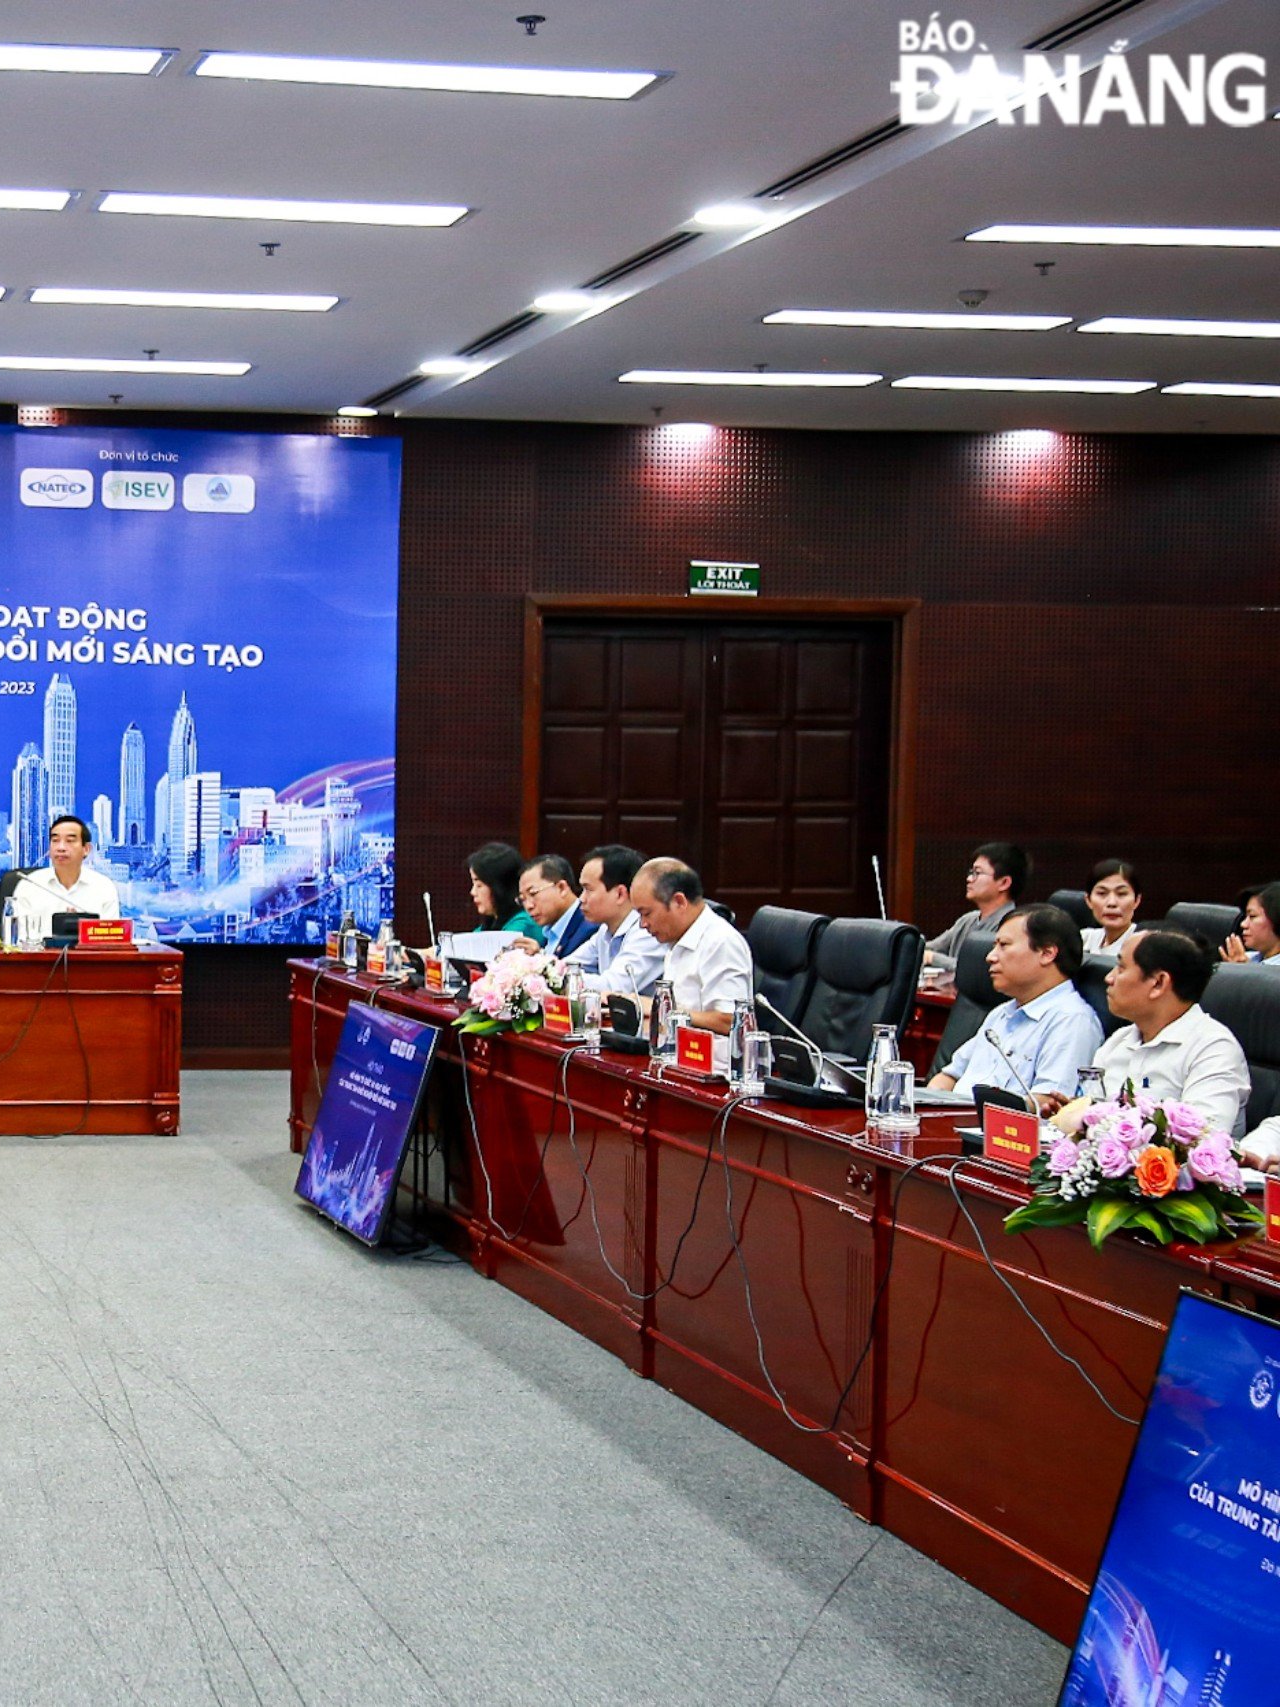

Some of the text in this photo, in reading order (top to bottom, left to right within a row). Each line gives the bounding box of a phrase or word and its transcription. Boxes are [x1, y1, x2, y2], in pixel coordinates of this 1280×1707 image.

[99, 450, 123, 461] Đơn
[125, 450, 135, 463] vị
[151, 451, 180, 463] chức
[38, 482, 78, 494] NATEC
[124, 481, 171, 499] ISEV
[706, 567, 744, 580] EXIT
[57, 602, 147, 635] ĐỘNG
[46, 635, 106, 664] MỚI
[112, 637, 195, 667] SÁNG
[202, 644, 264, 673] TẠO
[0, 680, 36, 695] 2023
[1237, 1478, 1262, 1503] MÔ
[1189, 1480, 1215, 1509] CỦA
[1216, 1494, 1260, 1531] TRUNG
